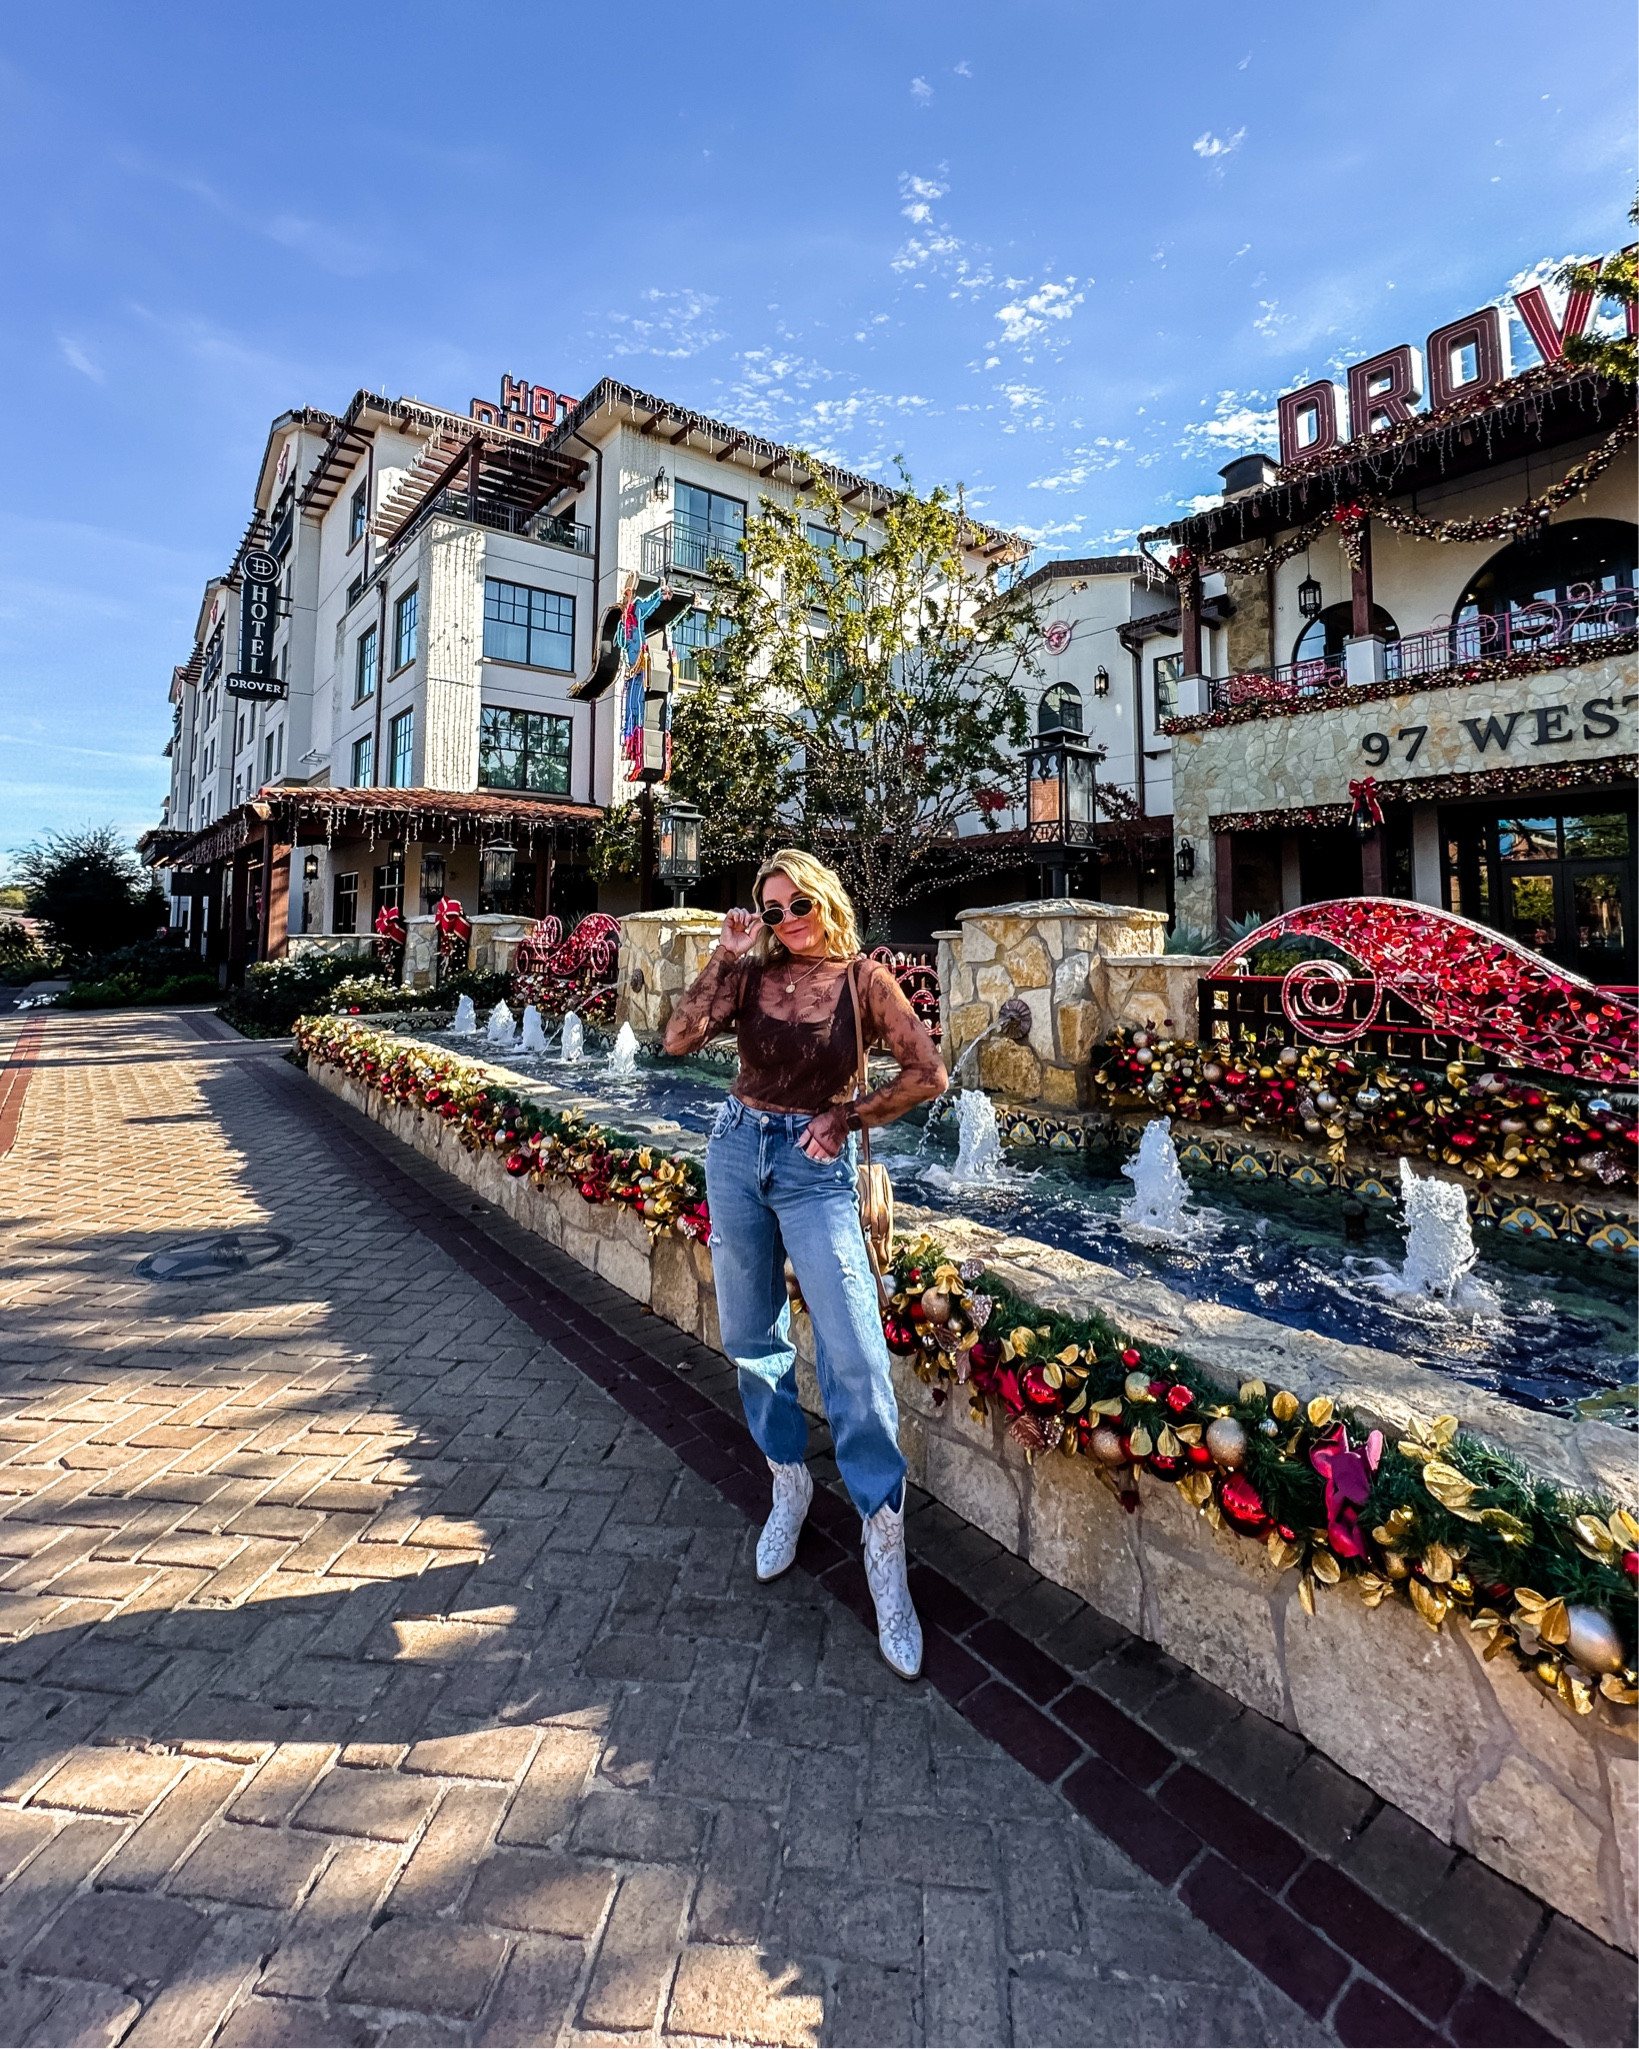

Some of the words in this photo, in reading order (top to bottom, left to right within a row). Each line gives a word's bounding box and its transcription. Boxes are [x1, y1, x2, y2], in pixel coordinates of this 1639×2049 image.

[1278, 241, 1638, 467] DROV
[250, 584, 269, 675] HOTEL
[229, 678, 282, 694] DROVER
[1361, 725, 1428, 767] 97
